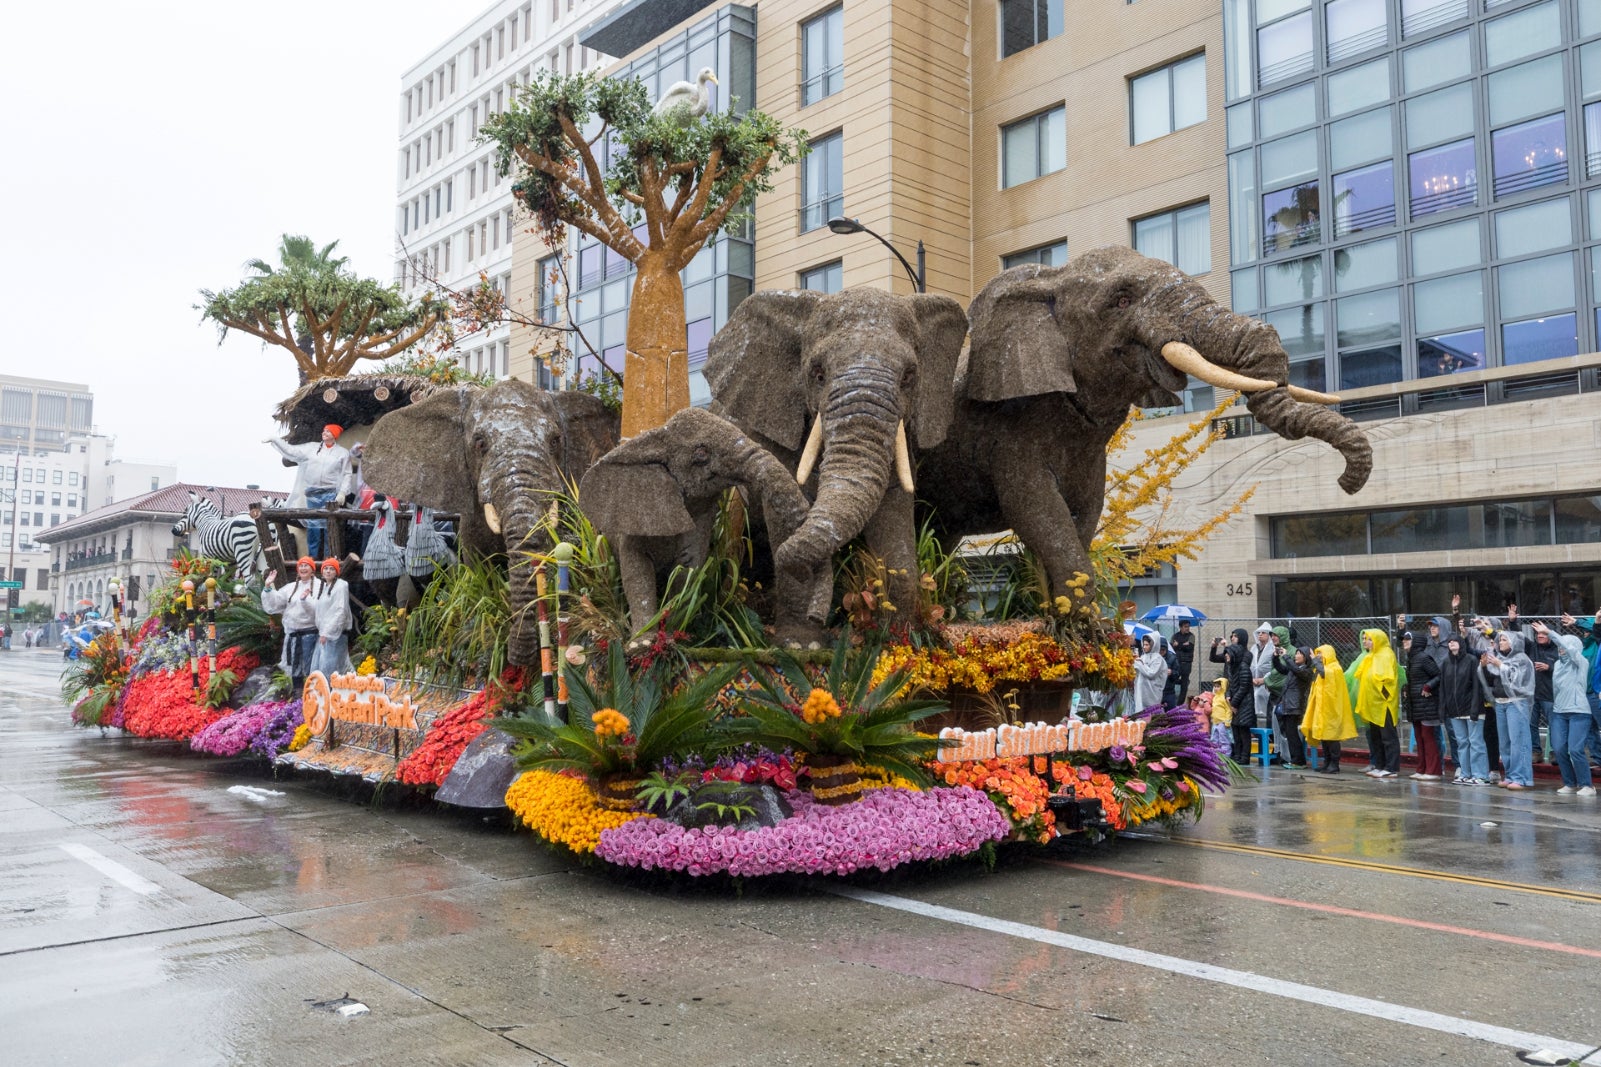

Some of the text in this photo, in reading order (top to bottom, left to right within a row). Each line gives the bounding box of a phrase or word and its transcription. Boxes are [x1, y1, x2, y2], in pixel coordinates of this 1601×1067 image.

[1226, 582, 1253, 597] 345
[330, 691, 418, 731] Safari Park
[939, 717, 1147, 762] Giant Strides Together
